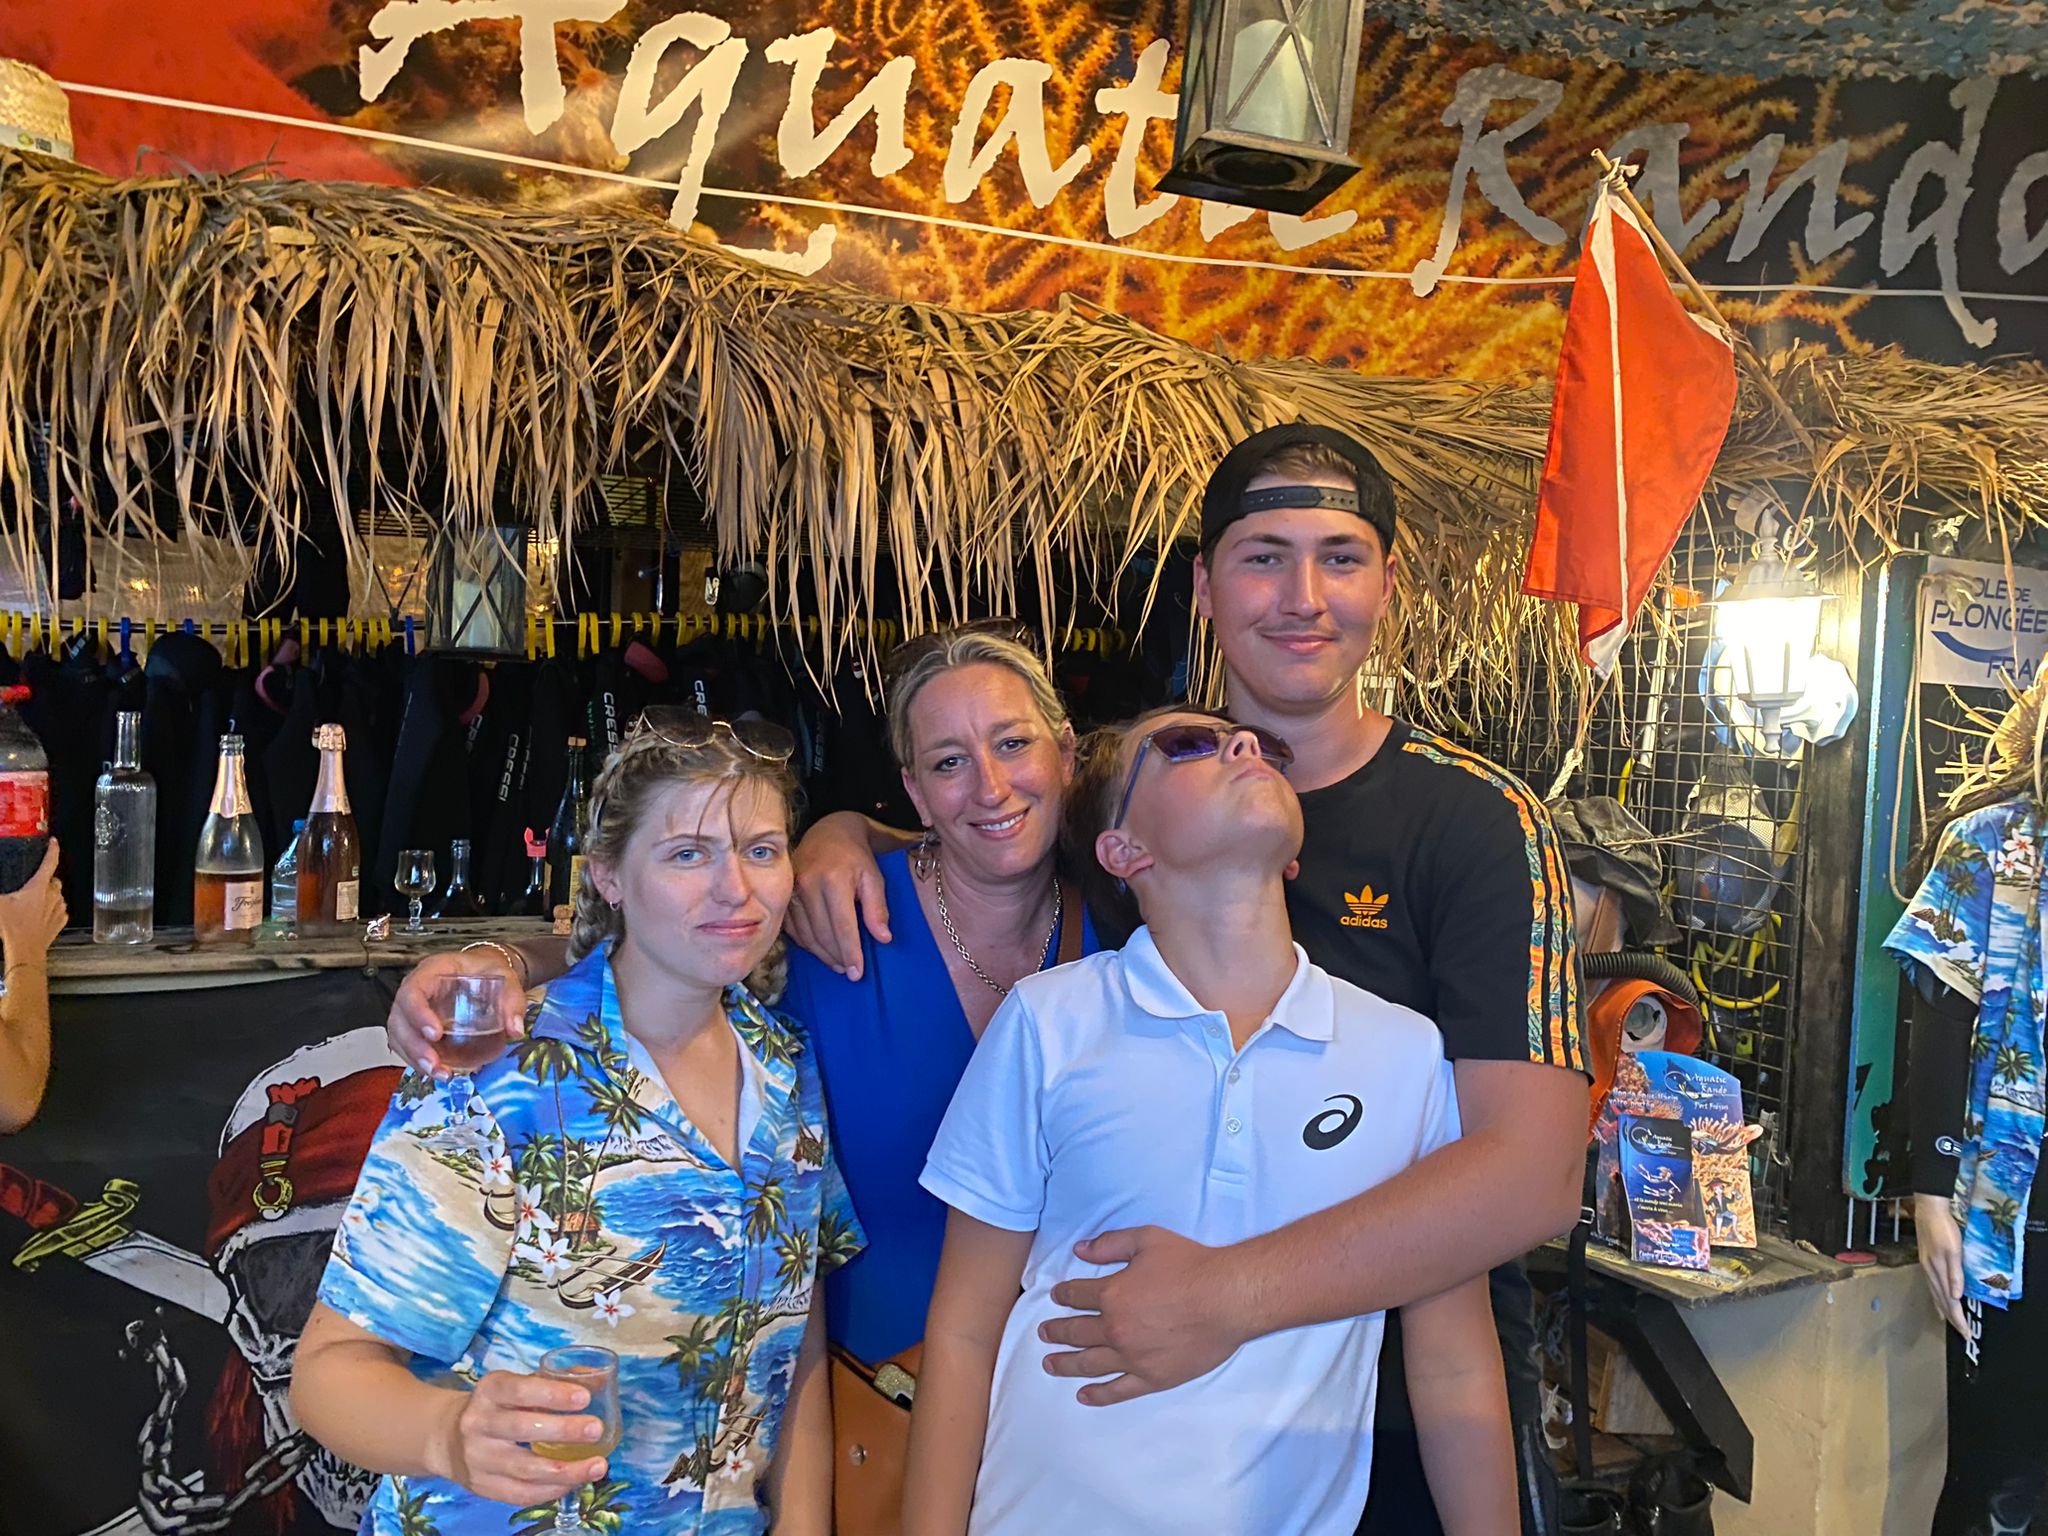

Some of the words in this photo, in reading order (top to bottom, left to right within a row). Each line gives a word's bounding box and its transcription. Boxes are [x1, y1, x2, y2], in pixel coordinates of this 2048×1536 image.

[359, 0, 1357, 276] Aquat
[497, 733, 520, 802] CRESSI
[1340, 915, 1388, 929] adidas
